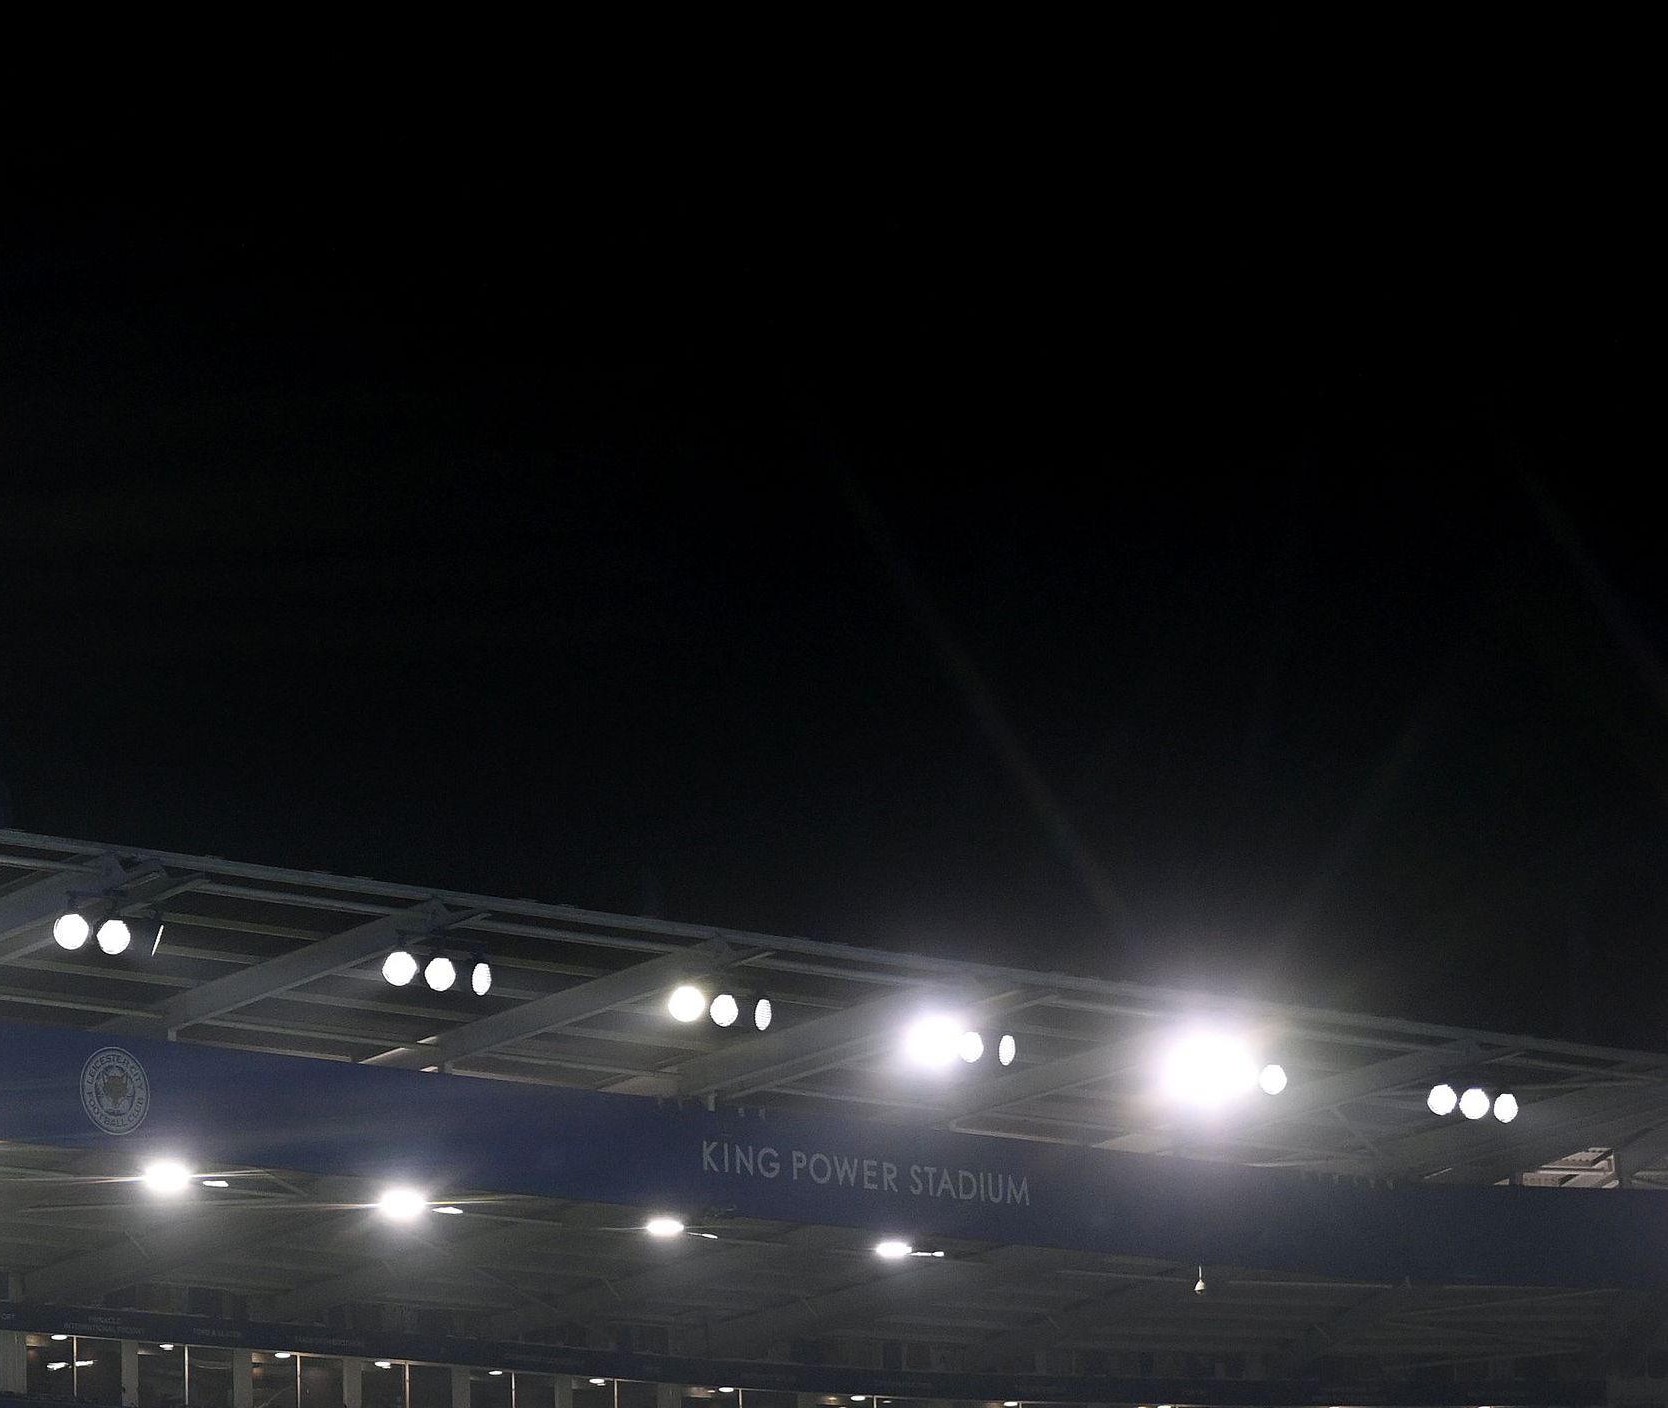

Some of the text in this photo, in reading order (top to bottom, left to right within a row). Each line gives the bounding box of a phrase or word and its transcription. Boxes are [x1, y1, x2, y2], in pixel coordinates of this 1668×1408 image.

[702, 1140, 1030, 1206] KING POWER STADIUM
